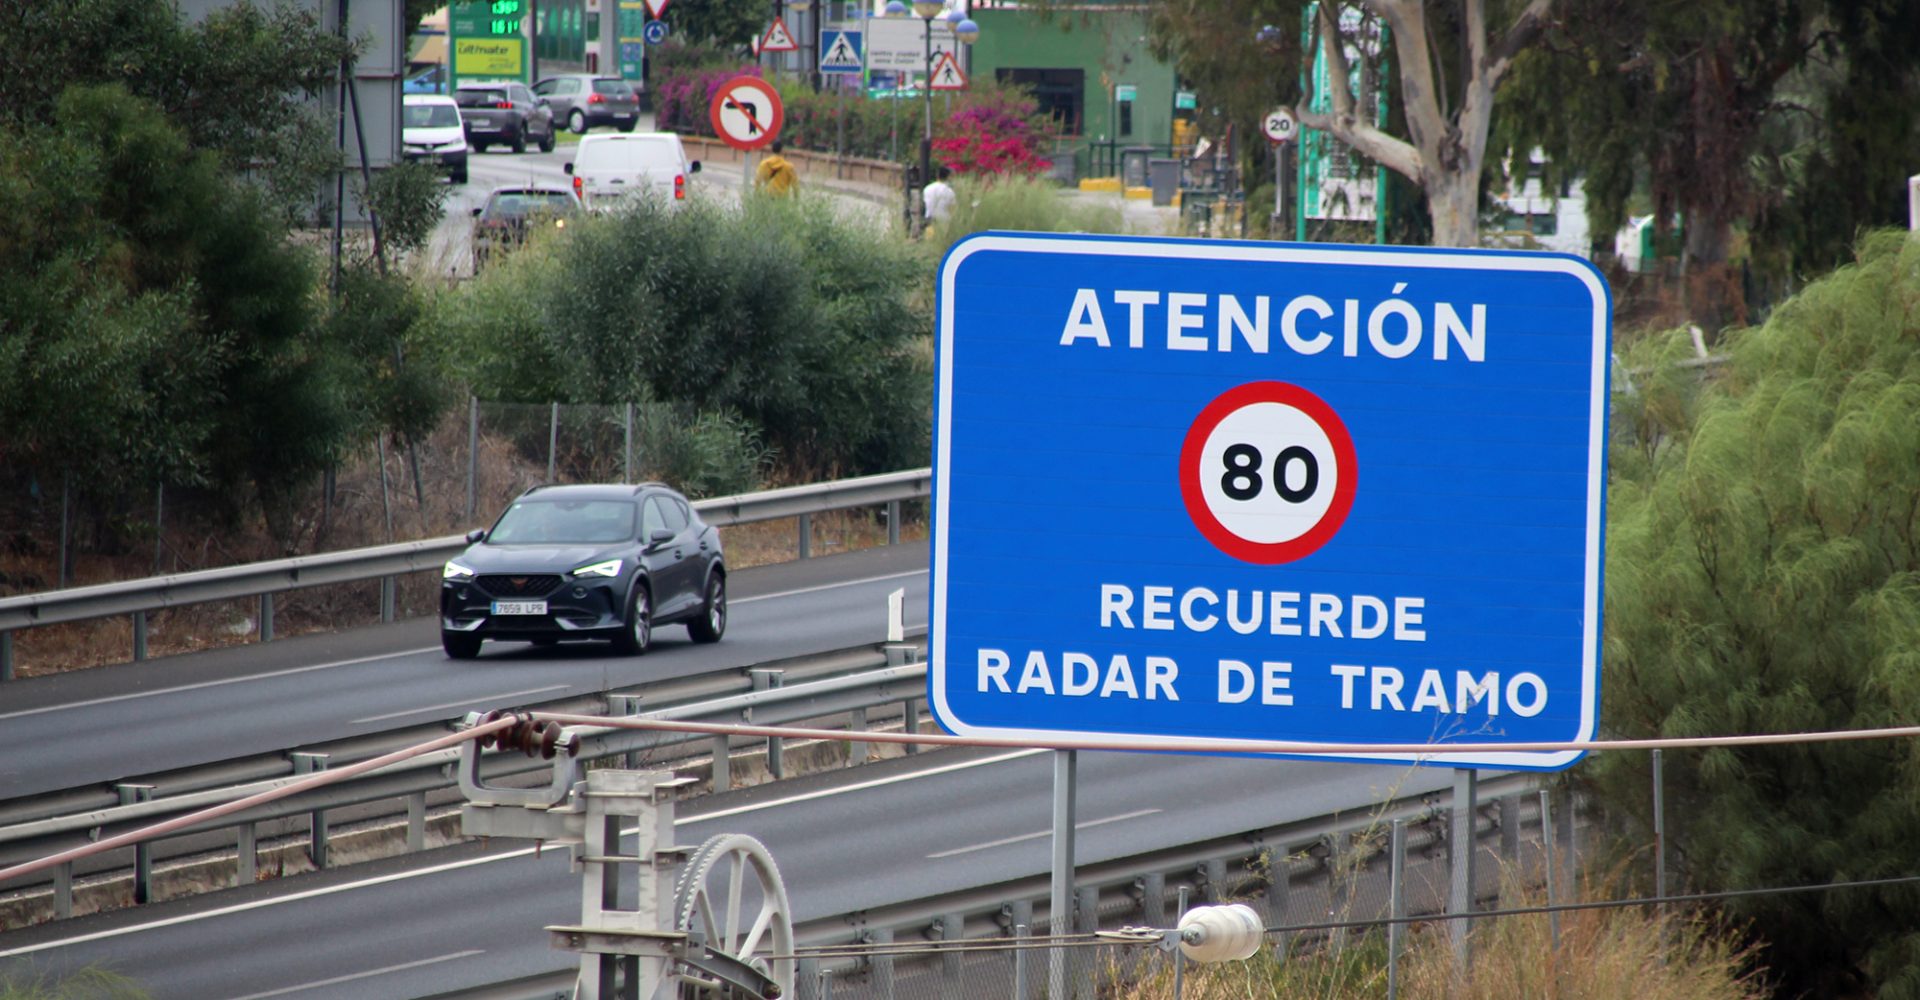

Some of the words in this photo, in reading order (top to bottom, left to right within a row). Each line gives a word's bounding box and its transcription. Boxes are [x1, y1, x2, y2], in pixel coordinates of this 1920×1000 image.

[1270, 119, 1290, 131] 20
[1060, 282, 1487, 362] ATENCIÓN
[1221, 444, 1319, 504] 80
[1101, 584, 1426, 642] RECUERDE
[977, 648, 1179, 702] RADAR
[1219, 659, 1294, 707] DE
[1331, 664, 1548, 718] TRAMO
